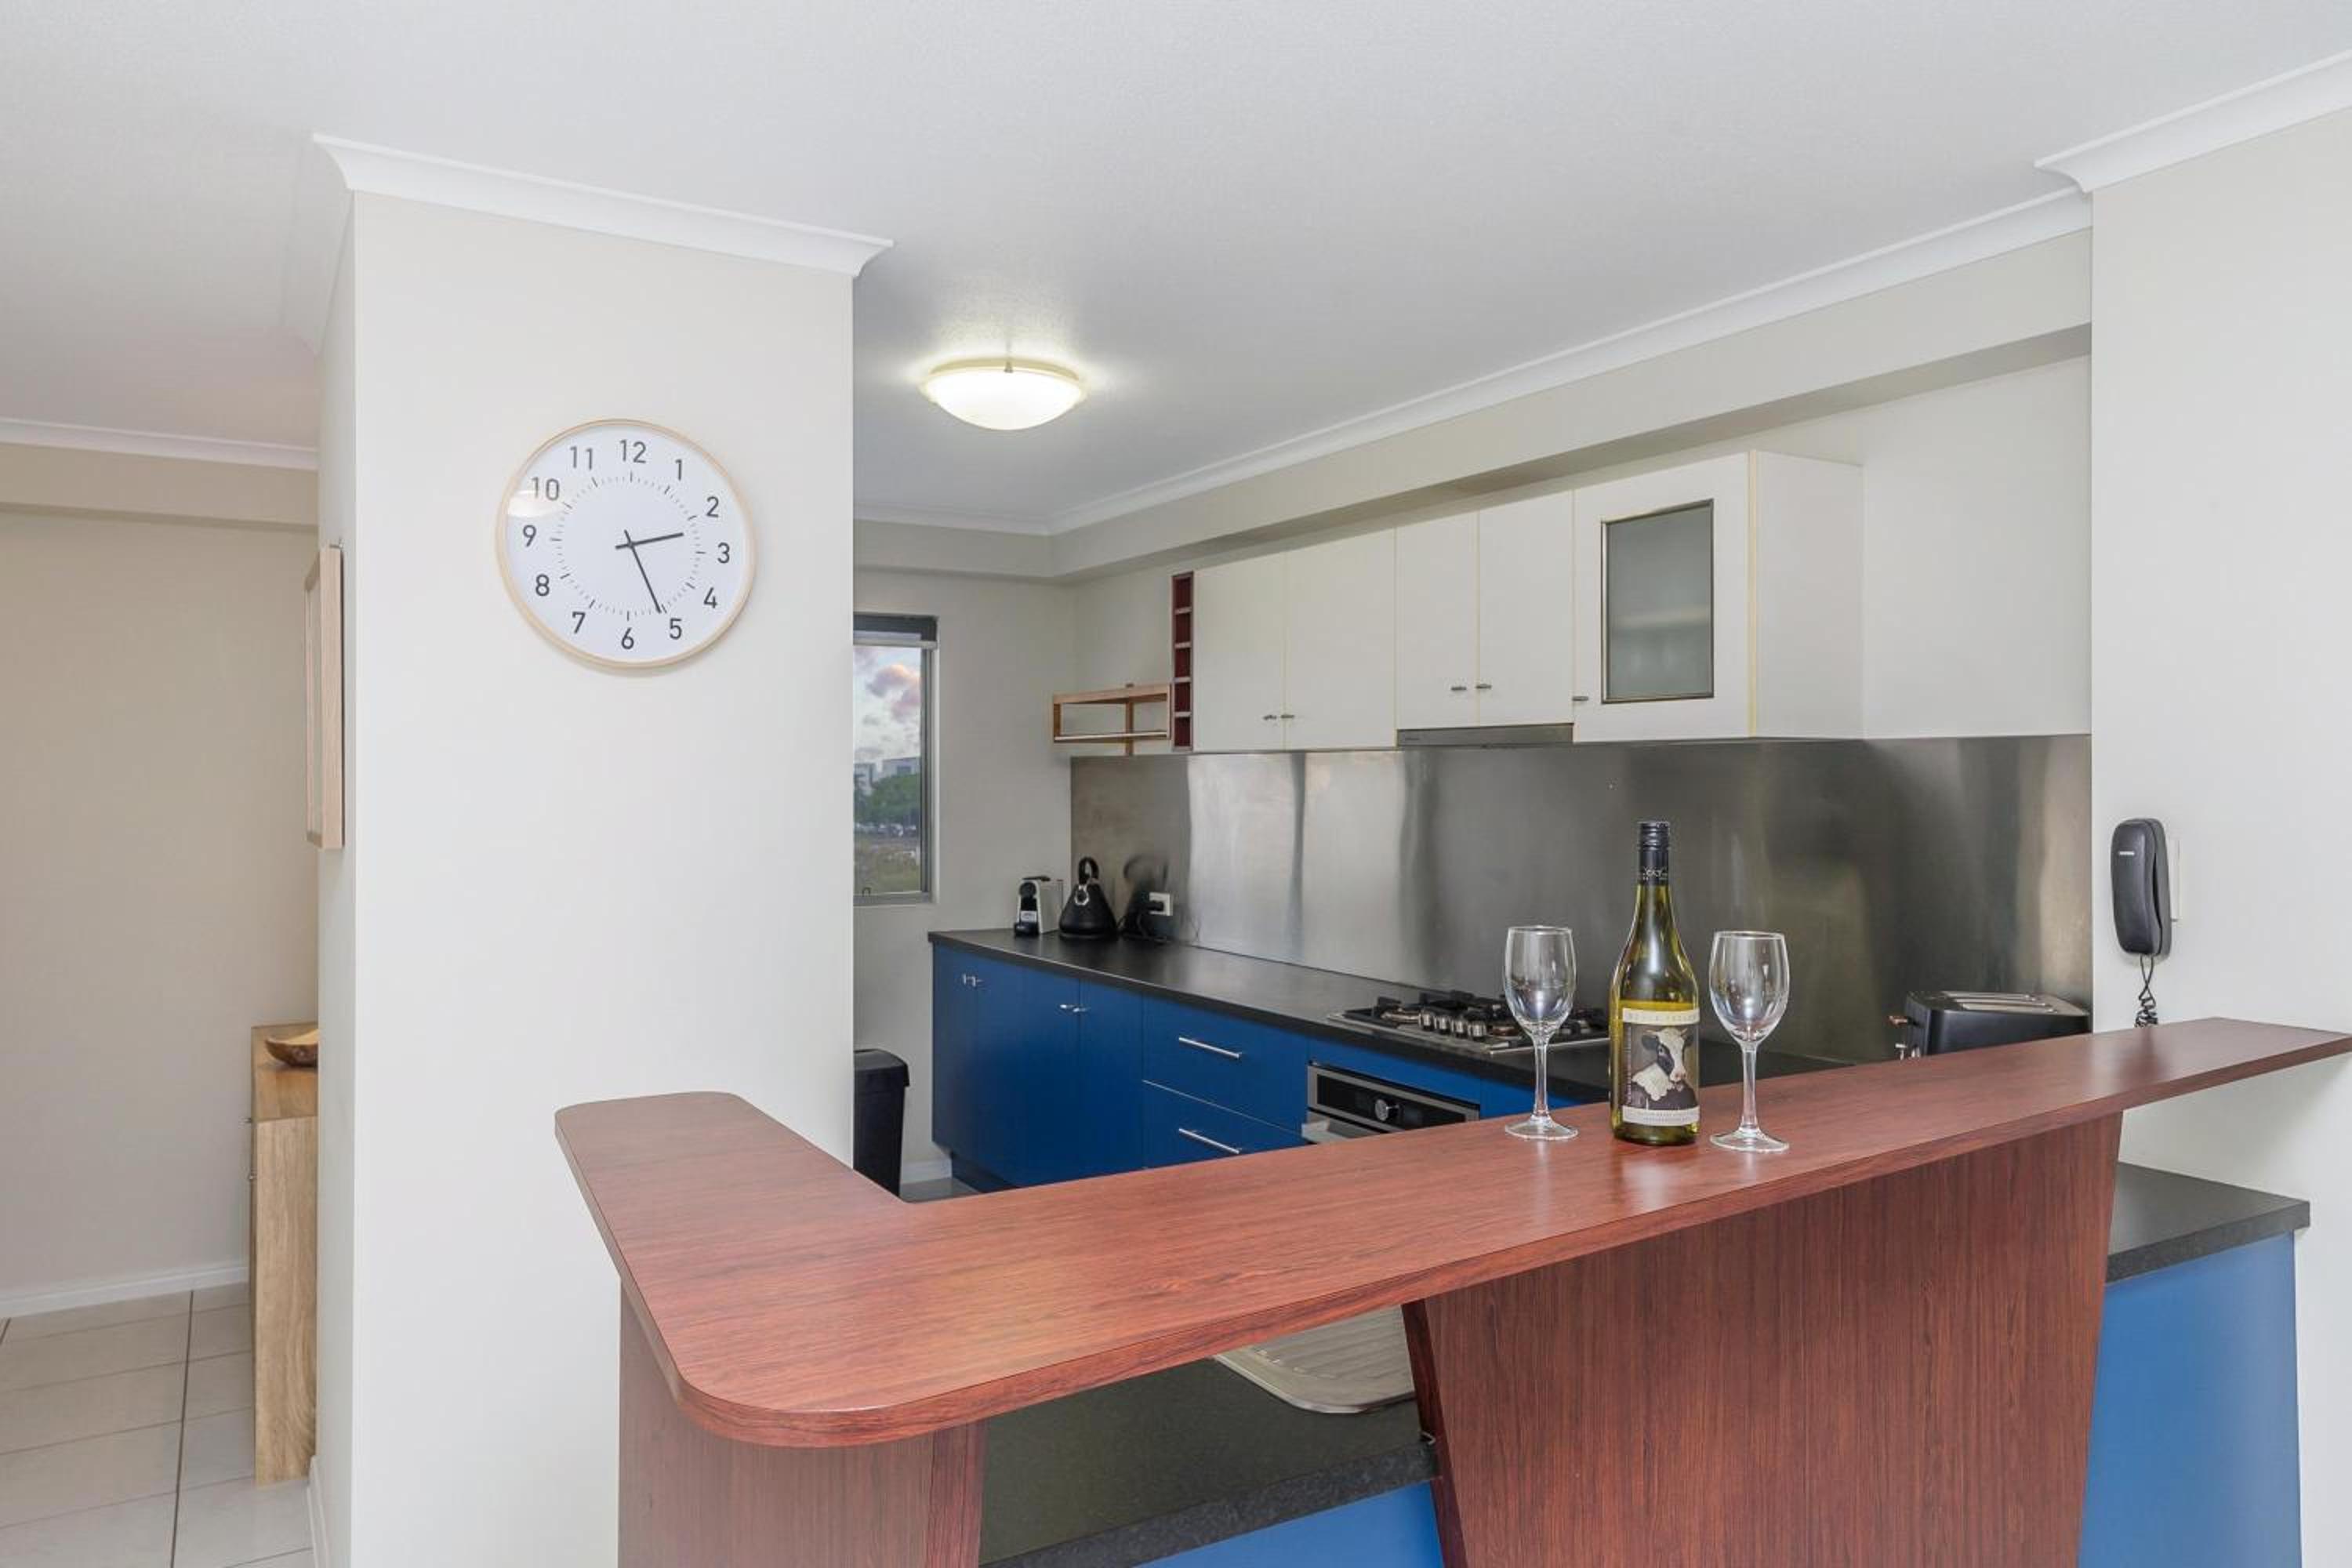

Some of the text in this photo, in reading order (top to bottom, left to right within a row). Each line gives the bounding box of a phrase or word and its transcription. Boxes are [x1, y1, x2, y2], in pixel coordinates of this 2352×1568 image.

[570, 445, 593, 471] 11
[619, 439, 647, 464] 12
[675, 459, 683, 481] 1
[532, 476, 560, 501] 10
[706, 495, 719, 518] 2
[522, 524, 537, 547] 9
[717, 542, 730, 564] 3
[535, 573, 550, 597] 8
[703, 586, 718, 609] 4
[572, 611, 586, 634] 7
[669, 617, 683, 641] 5
[620, 627, 635, 650] 6
